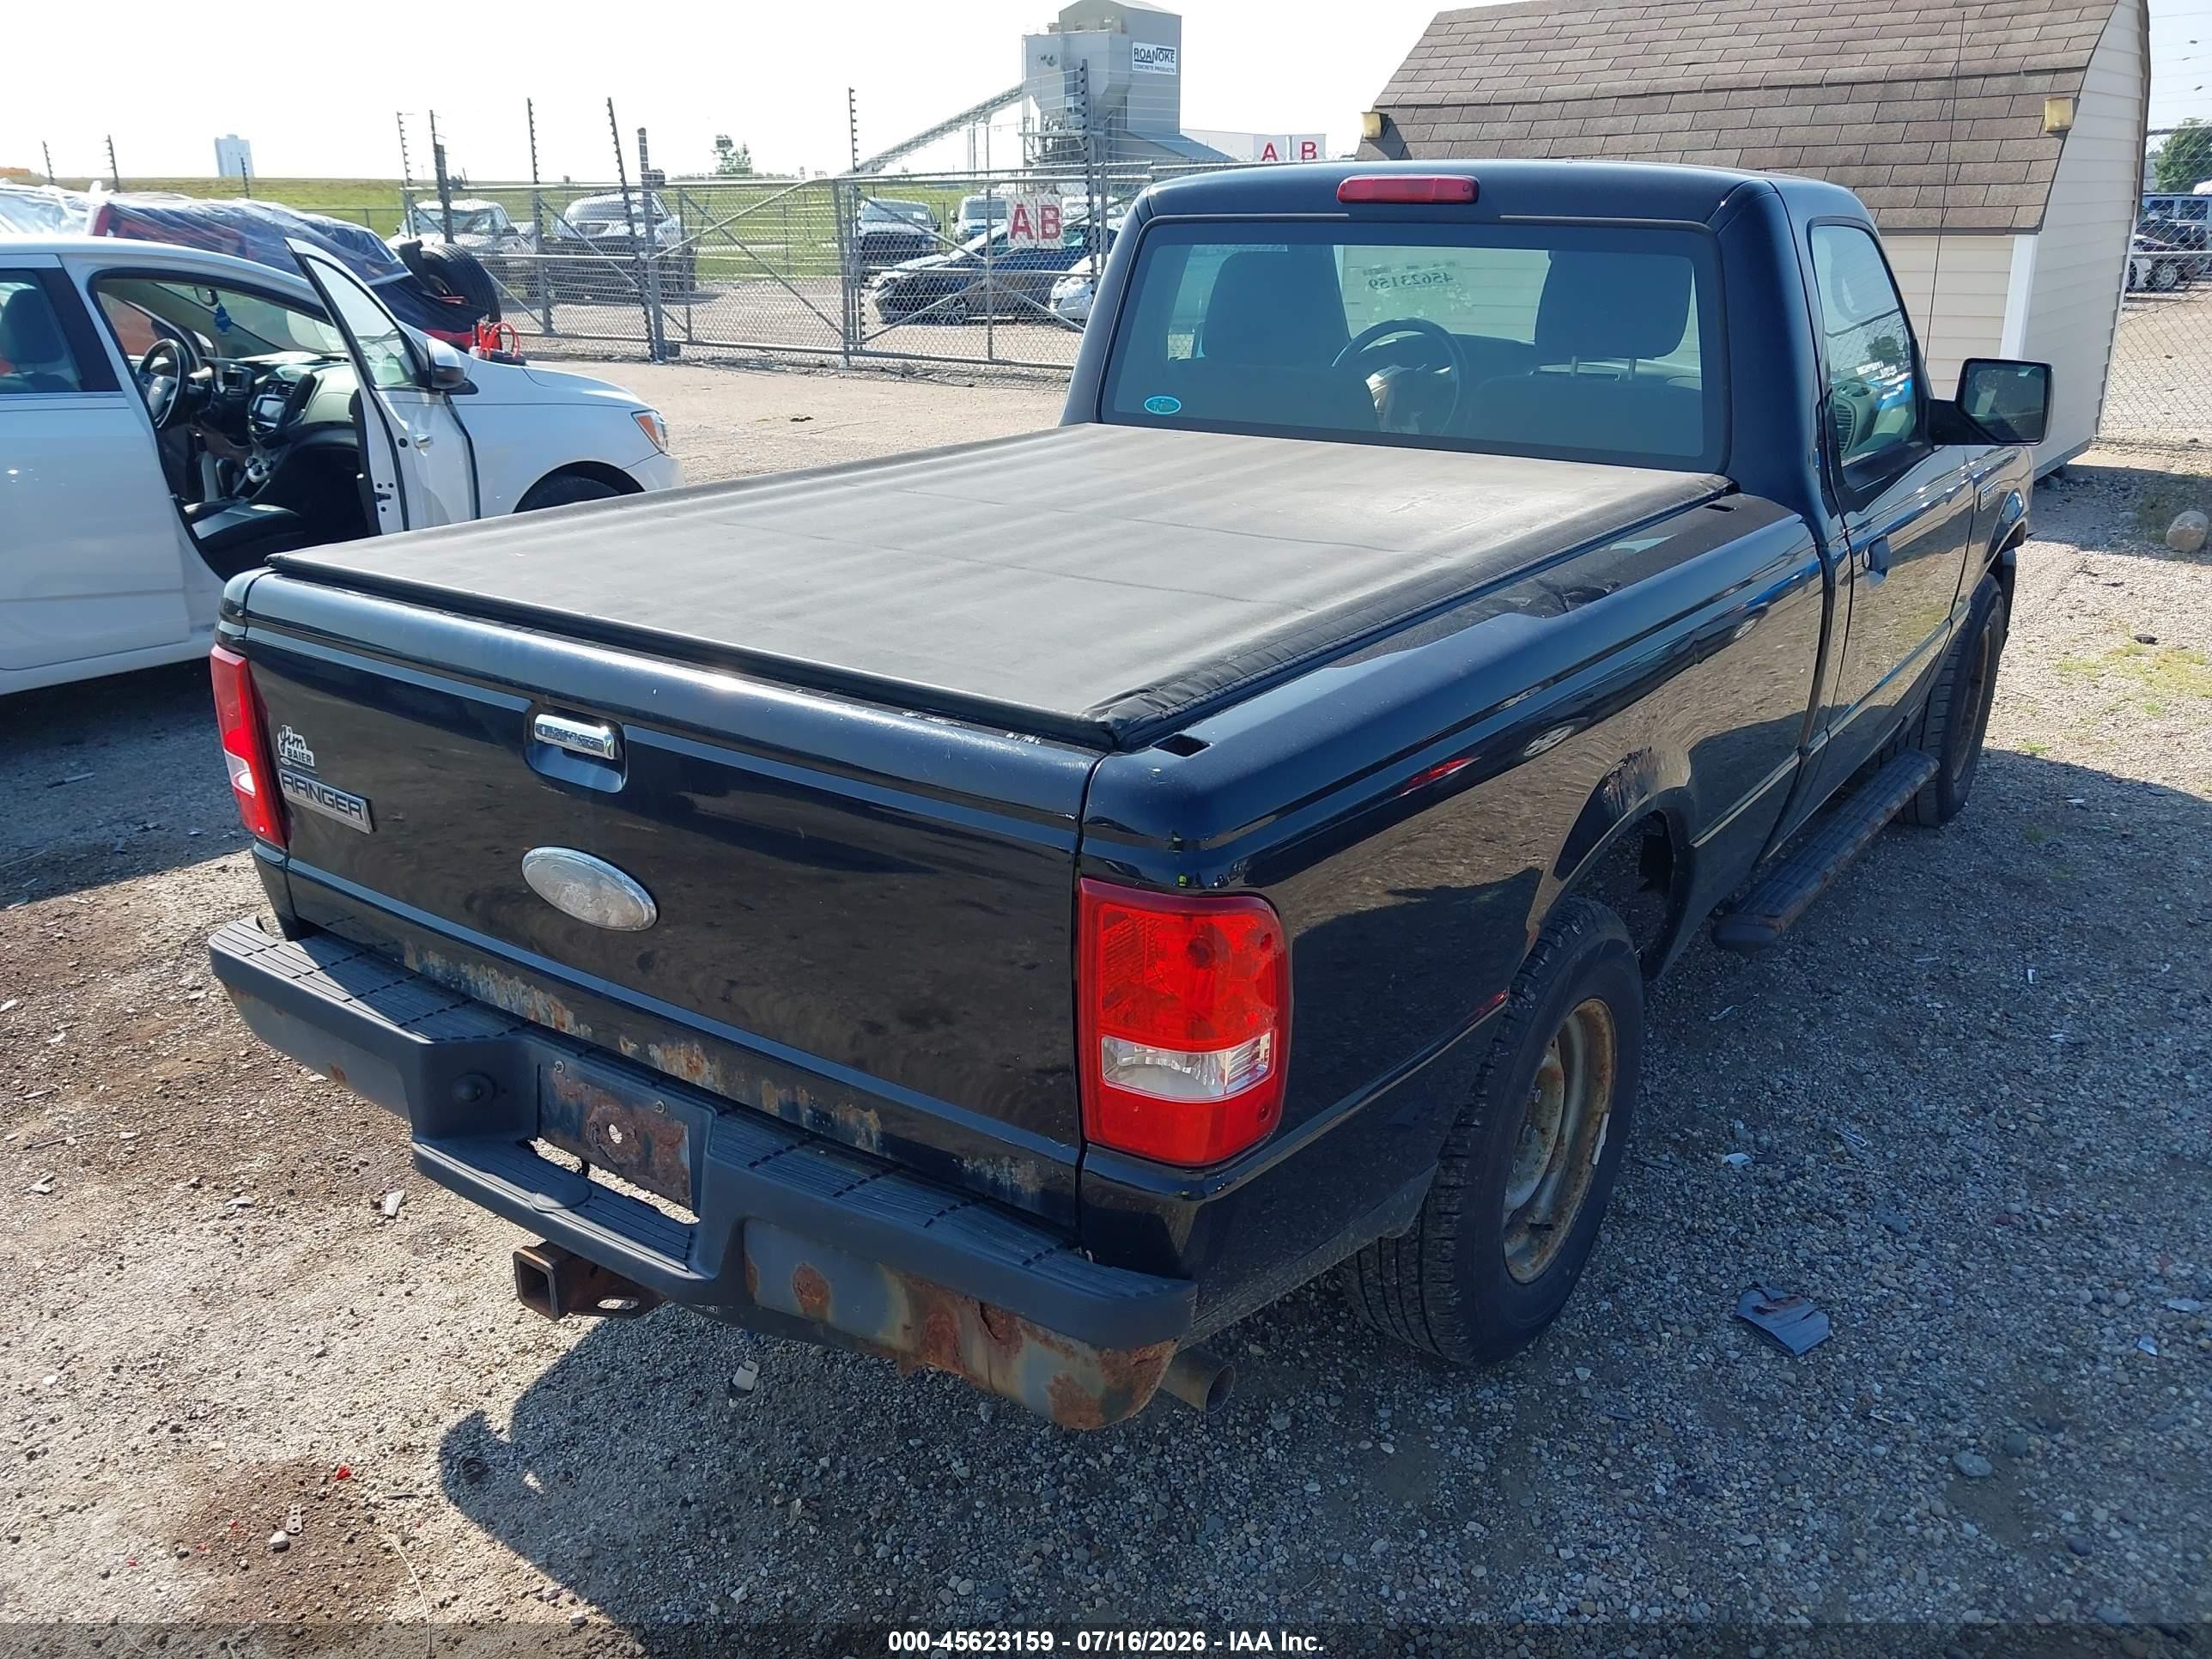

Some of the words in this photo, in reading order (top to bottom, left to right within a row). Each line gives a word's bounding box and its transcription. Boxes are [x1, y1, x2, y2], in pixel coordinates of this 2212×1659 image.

[1133, 46, 1176, 64] ROANOKE
[1261, 142, 1278, 161] A
[1301, 141, 1317, 161] B
[1010, 204, 1034, 240] A
[1040, 204, 1060, 240] B
[287, 747, 313, 765] BAIER
[282, 775, 364, 821] RANGER
